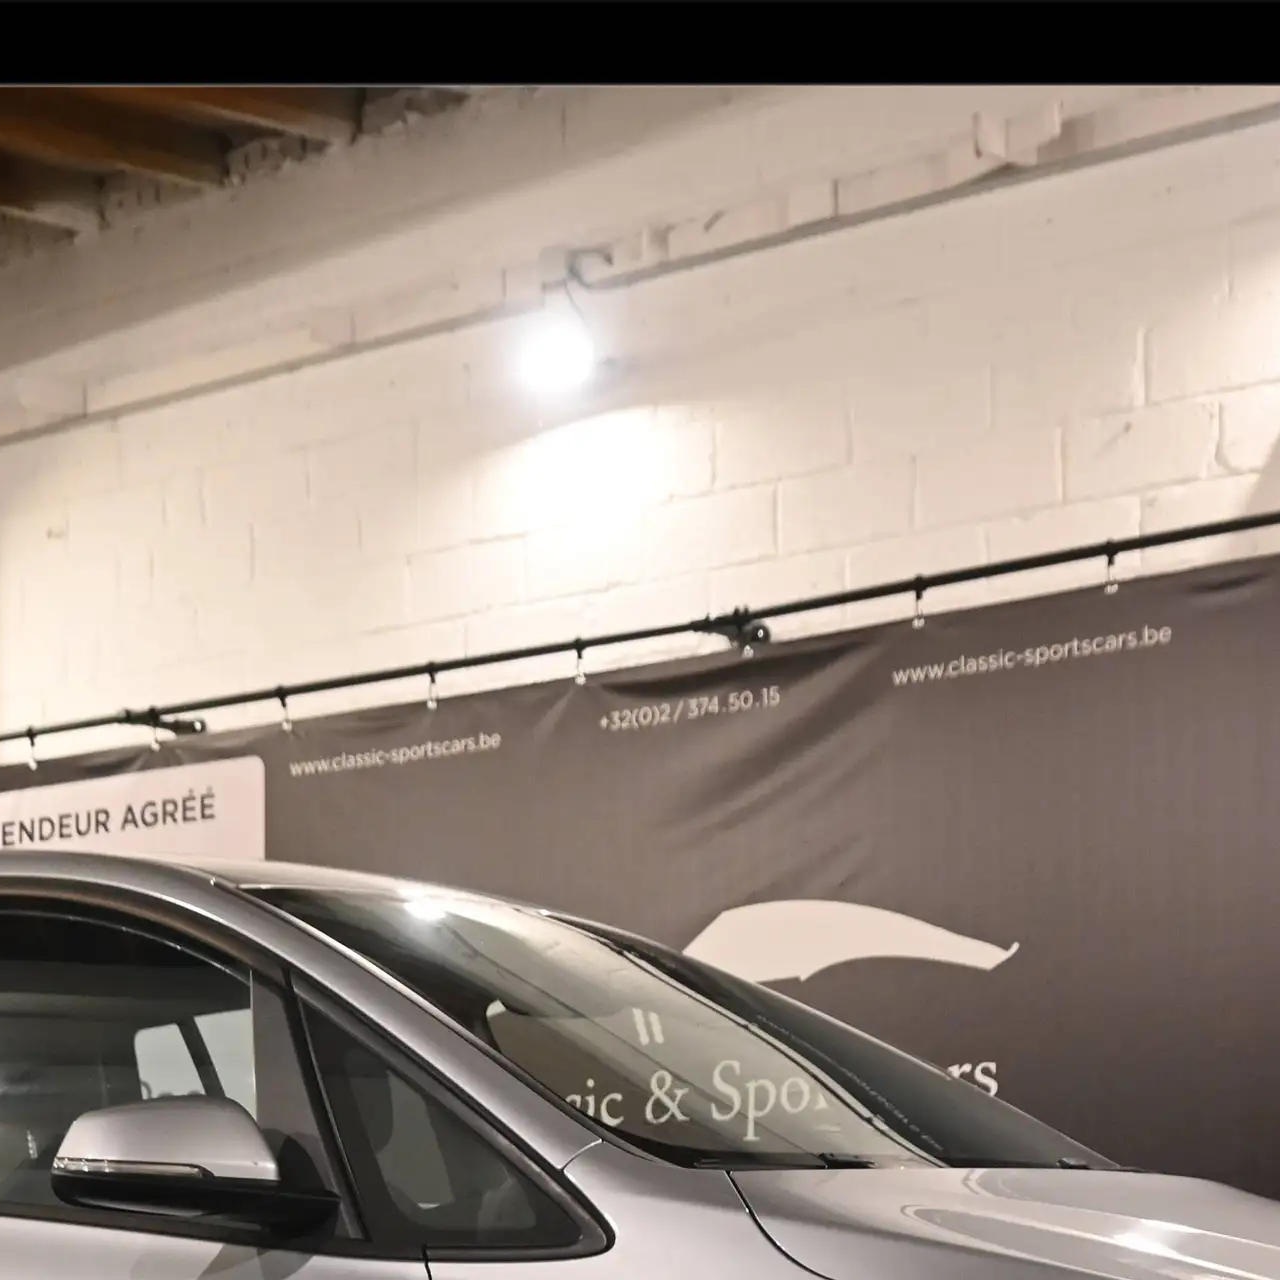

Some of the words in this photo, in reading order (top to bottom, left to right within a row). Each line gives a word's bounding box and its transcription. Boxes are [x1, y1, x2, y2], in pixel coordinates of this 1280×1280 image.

[891, 623, 1173, 686] www.classic-sportscars.be
[288, 731, 503, 777] www.classic-sportscars.be
[120, 785, 217, 832] AGRÉÉ
[644, 1068, 691, 1125] &
